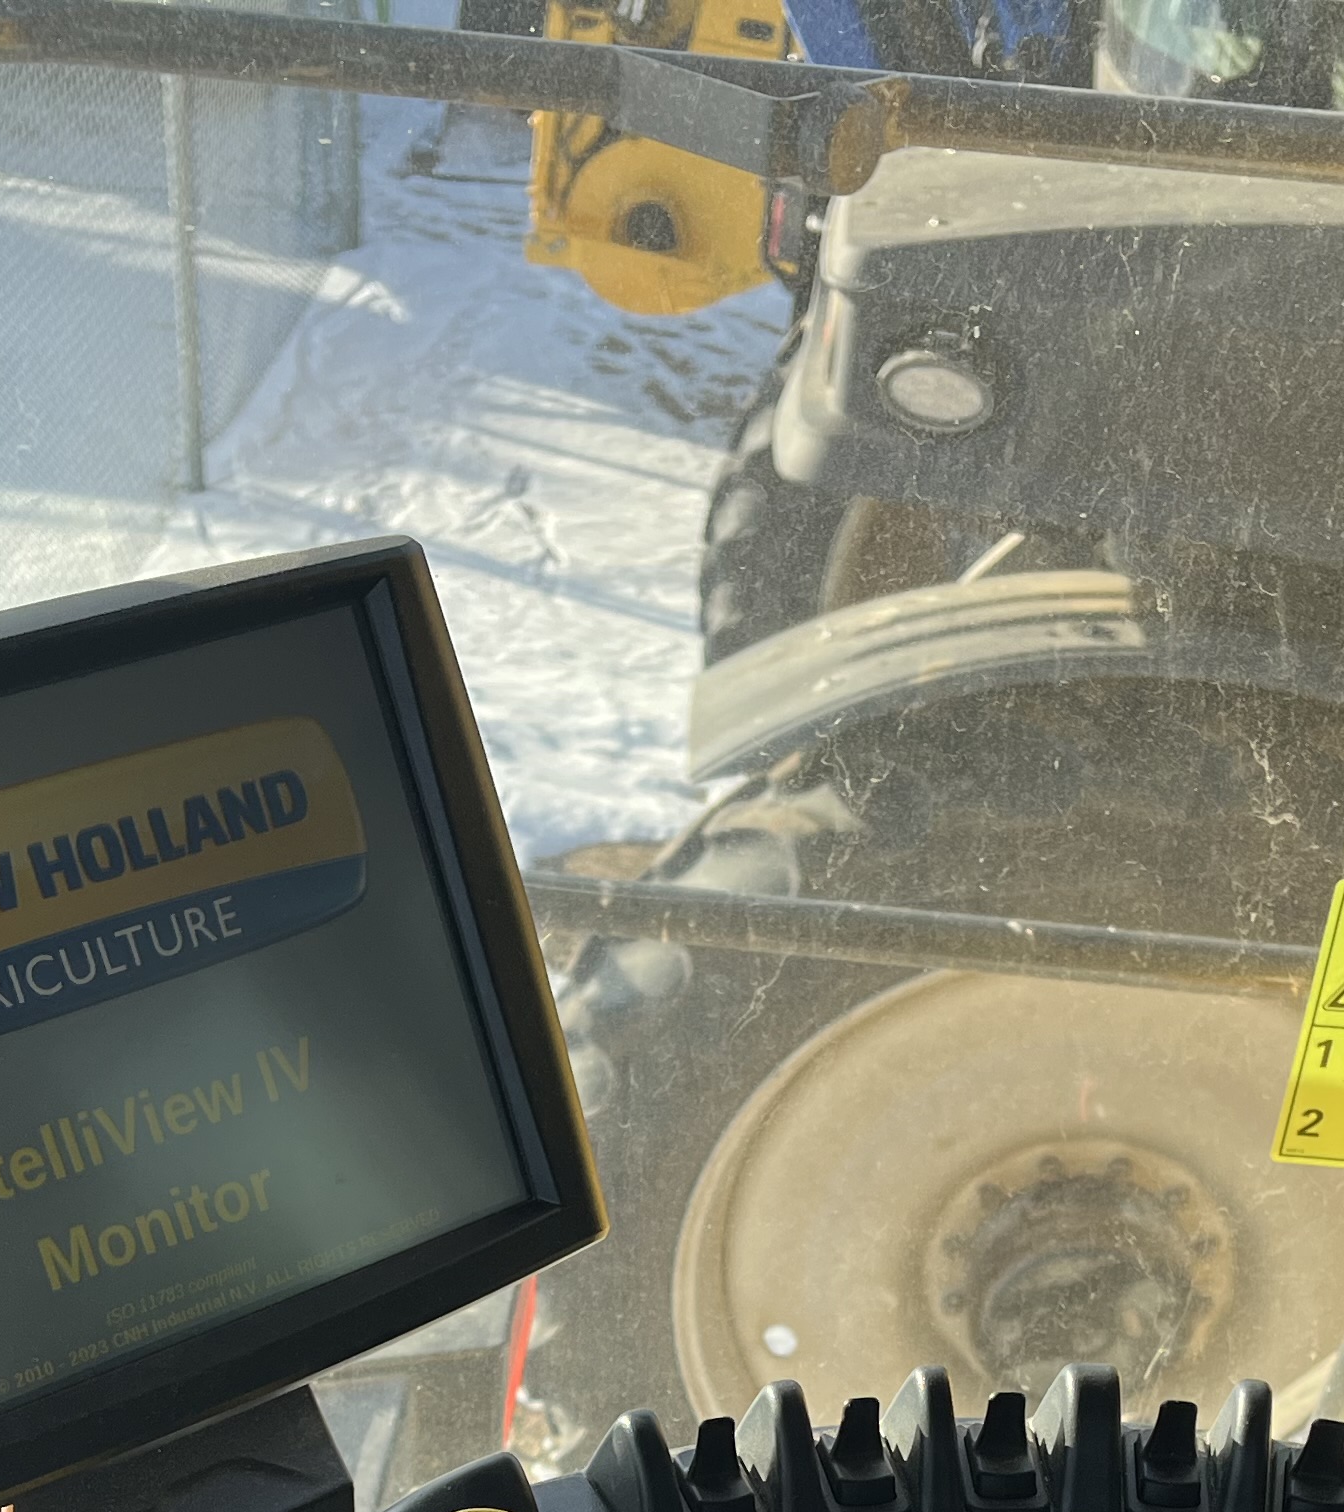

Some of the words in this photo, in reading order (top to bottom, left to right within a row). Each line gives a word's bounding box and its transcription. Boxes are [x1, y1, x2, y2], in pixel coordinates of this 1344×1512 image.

[27, 768, 309, 899] HOLLAND
[256, 1035, 310, 1102] IV
[1317, 1039, 1333, 1068] 1
[1297, 1108, 1323, 1138] 2
[36, 1168, 271, 1291] Monitor
[14, 1360, 55, 1388] 2010
[68, 1339, 110, 1367] 2023
[113, 1325, 150, 1349] CNH
[152, 1292, 228, 1335] Industrial
[265, 1268, 294, 1290] ALL
[297, 1242, 358, 1276] RIGHTS
[140, 1281, 186, 1315] 11783
